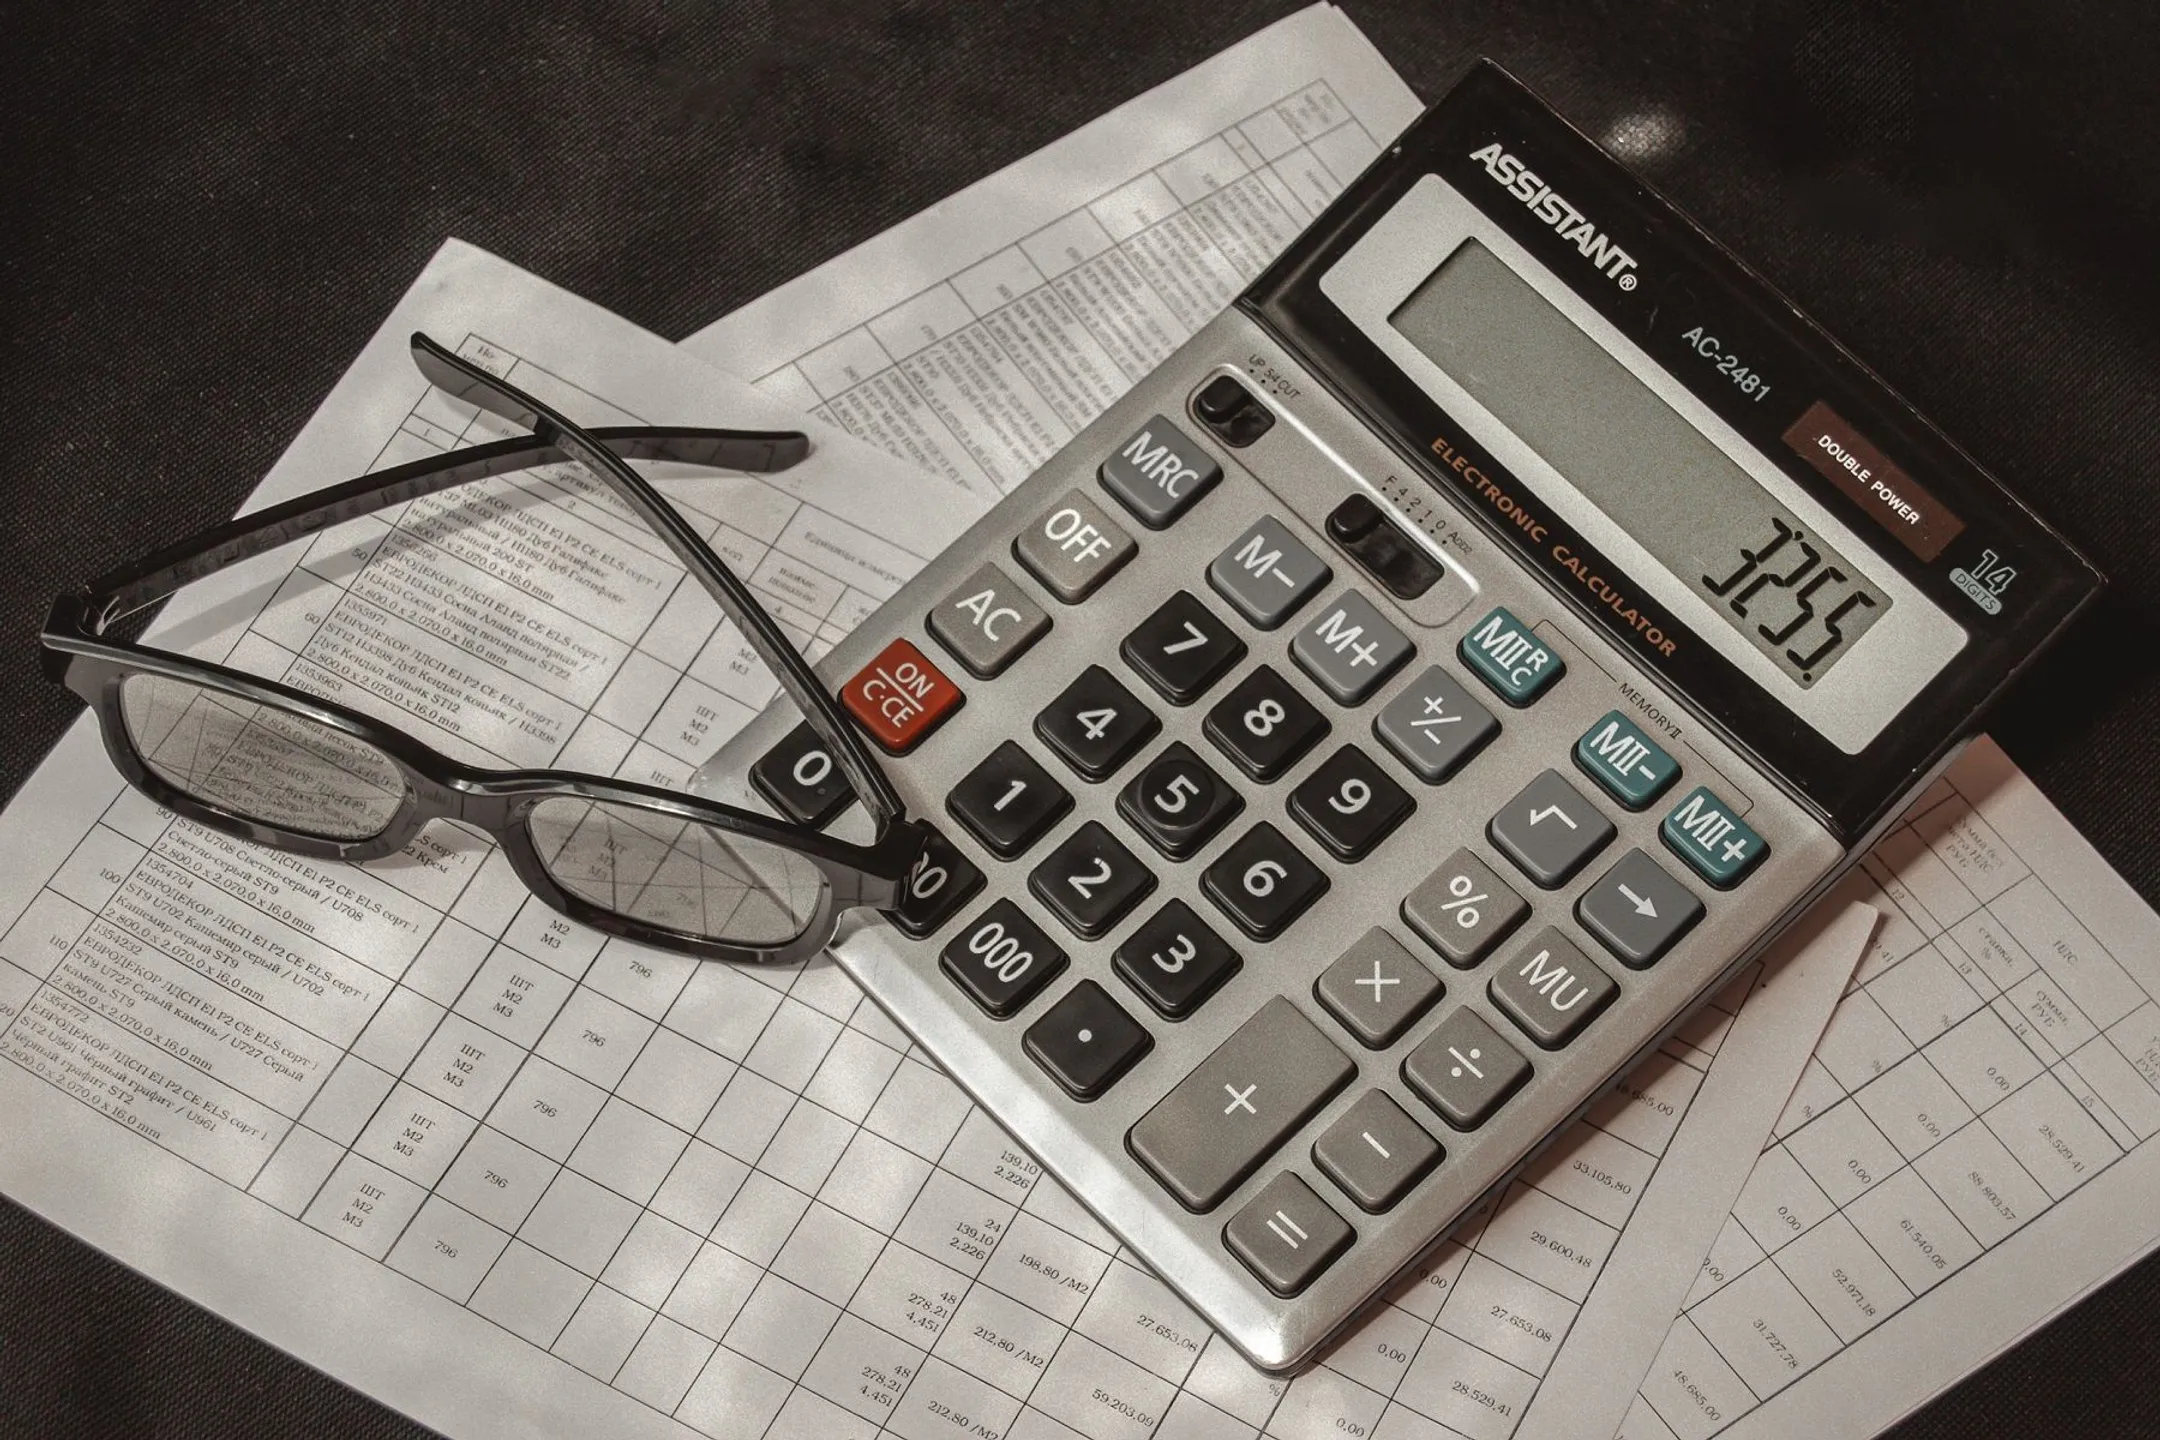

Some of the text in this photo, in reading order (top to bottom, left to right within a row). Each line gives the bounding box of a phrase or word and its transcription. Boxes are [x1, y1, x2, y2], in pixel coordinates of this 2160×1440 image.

[1681, 326, 1771, 403] AC-2481
[1279, 379, 1300, 400] CUT
[1122, 430, 1199, 500] MRC
[1818, 435, 1921, 525] DOUBLE POWER
[1398, 487, 1408, 498] 4
[1411, 498, 1421, 507] 2
[1424, 509, 1432, 518] 1
[1045, 507, 1113, 563] OFF
[1431, 437, 1676, 658] ELECTRONIC CALCULATOR
[1969, 548, 2017, 596] 14
[1954, 571, 1998, 612] DIGITS
[956, 588, 1021, 644] AC
[1163, 622, 1209, 656] 7
[895, 661, 935, 698] ON
[1075, 708, 1118, 740] 4
[1243, 698, 1286, 737] 8
[792, 750, 832, 787] 0
[993, 780, 1027, 811] 1
[1154, 775, 1199, 813] 5
[1328, 777, 1372, 814] 9
[100, 868, 121, 884] 100
[1068, 858, 1113, 898] 2
[1243, 860, 1288, 898] 6
[629, 961, 652, 978] 796
[969, 922, 1034, 984] 000
[1152, 934, 1196, 974] 3
[1519, 949, 1589, 1012] MU
[581, 1030, 605, 1047] 796
[533, 1100, 557, 1118] 796
[484, 1170, 508, 1188] 796
[985, 1218, 1001, 1232] 24
[435, 1241, 458, 1258] 796
[940, 1292, 957, 1304] 48
[894, 1365, 911, 1378] 48
